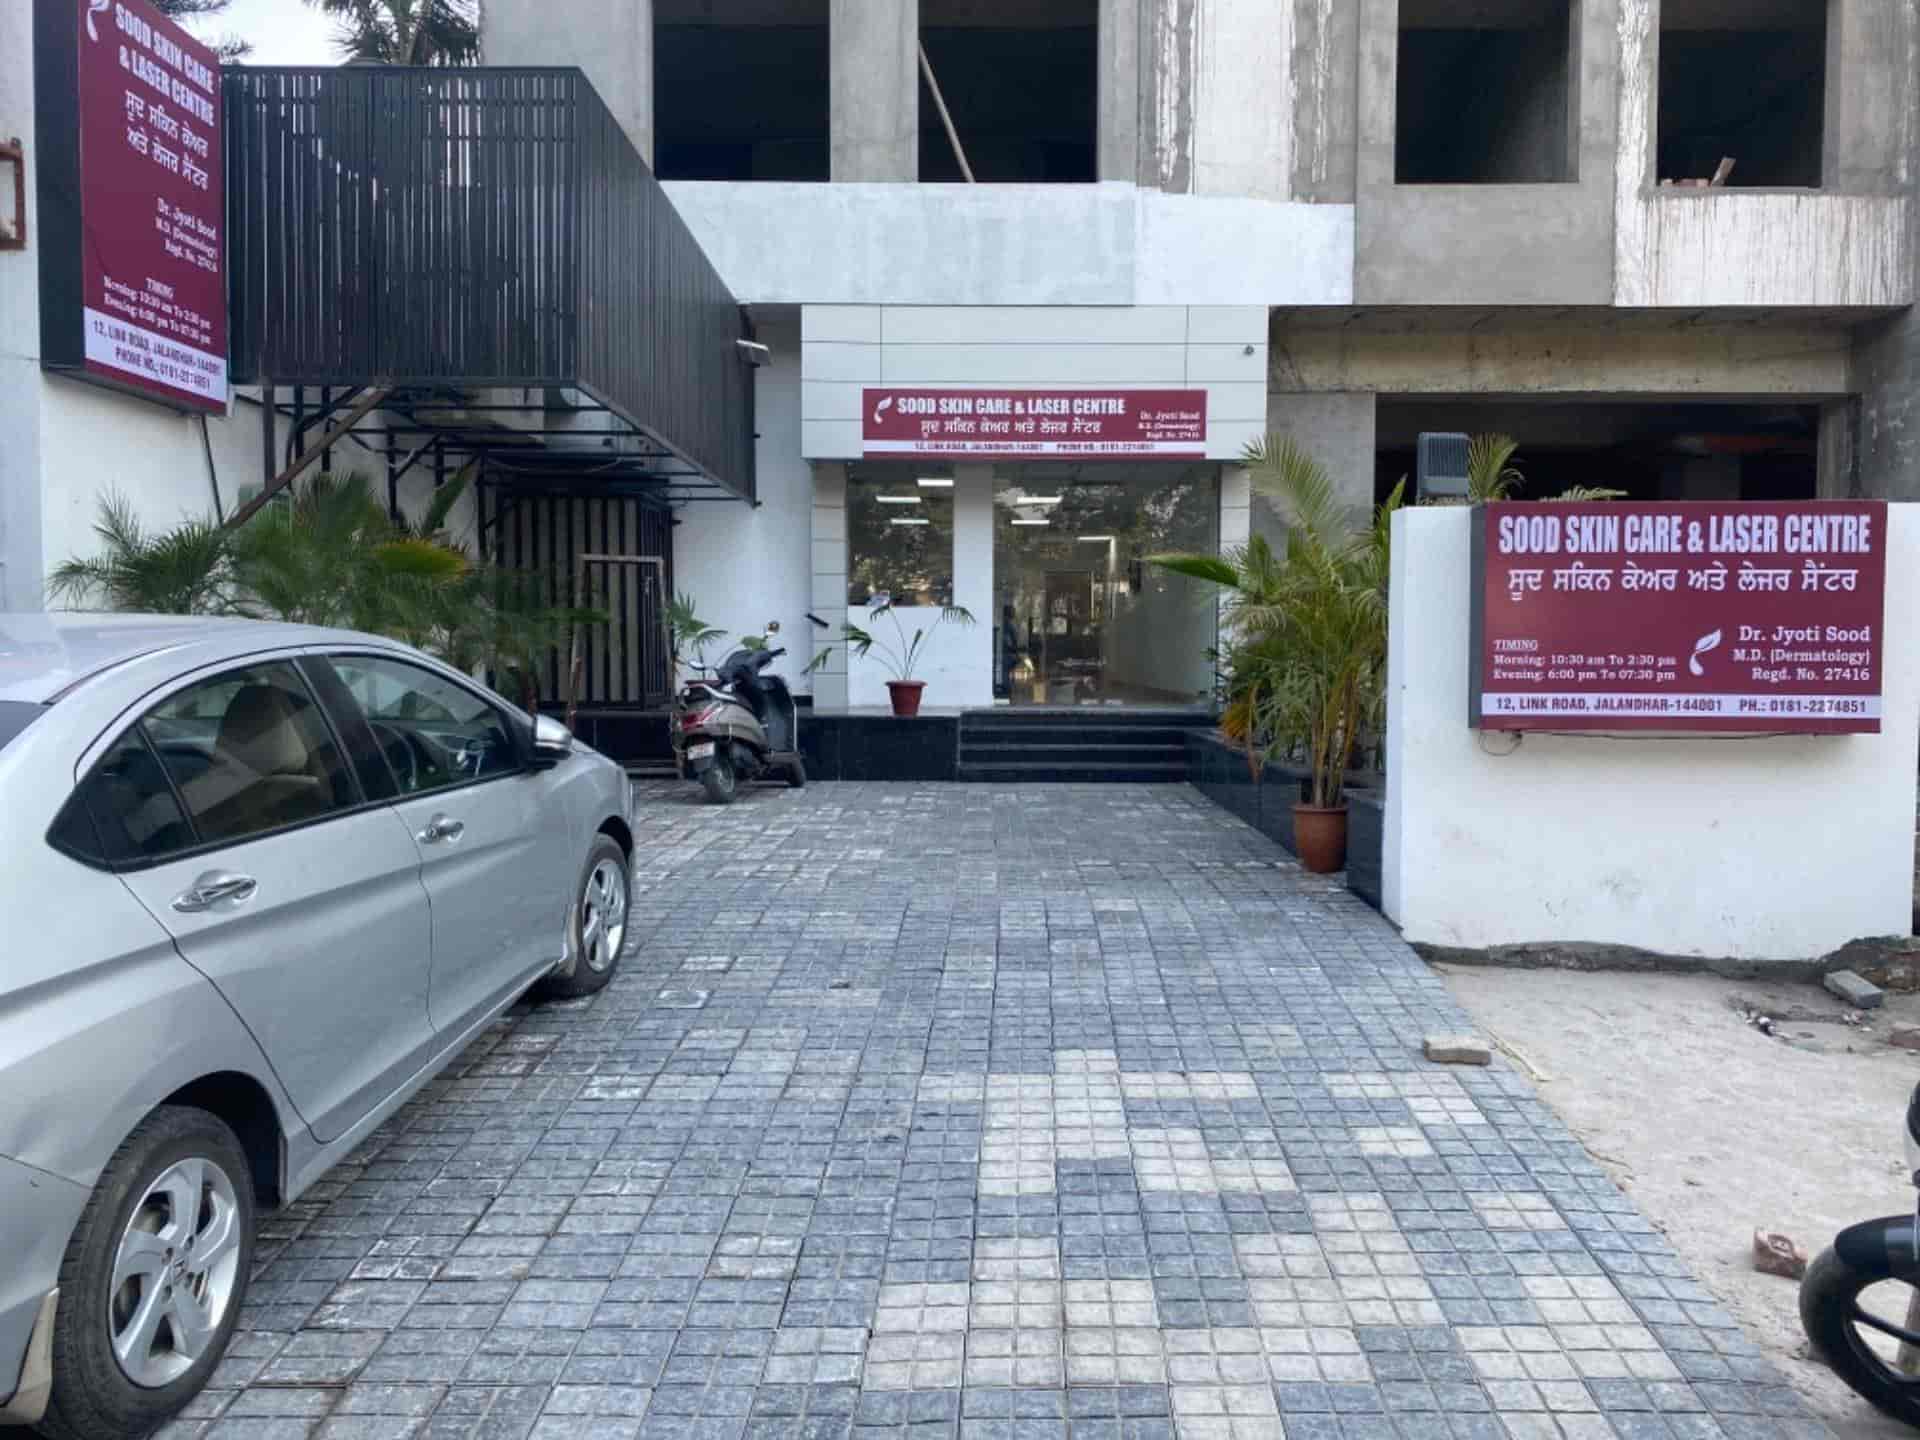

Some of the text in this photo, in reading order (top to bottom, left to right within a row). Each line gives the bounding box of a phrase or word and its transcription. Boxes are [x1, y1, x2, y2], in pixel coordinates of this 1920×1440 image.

[115, 2, 214, 95] SOOD SKIN CARE
[119, 45, 214, 127] & LASER CENTRE
[897, 398, 1125, 414] SOOD SKIN CARE & LASER CENTRE
[1499, 515, 1871, 553] SOOD SKIN CARE & LASER CENTRE
[1508, 559, 1859, 600] ਸੂਦ ਸਕਿਨ ਕੇਅਰ ਅਤੇ ਲੇਜਰ ਸੈਂਟਰ
[1739, 625, 1871, 646] Dr. Jyoti Sood
[1494, 639, 1538, 651] TIMING
[1493, 654, 1677, 668] Morning: 10:30 am To 2:30 pm
[1733, 648, 1871, 665] M.D. (Dermatology)
[1548, 670, 1575, 681] 6:00
[1577, 672, 1597, 683] pm
[1600, 670, 1616, 681] To
[1618, 670, 1652, 681] 07:30
[1656, 672, 1676, 683] pm
[1752, 667, 1870, 683] Regd. No. 27416
[1496, 697, 1516, 712] 12,
[1519, 697, 1548, 709] LINK
[1551, 697, 1590, 711] ROAD,
[1593, 698, 1721, 711] JALANDHAR-144001
[1770, 700, 1866, 713] 0181-2274851
